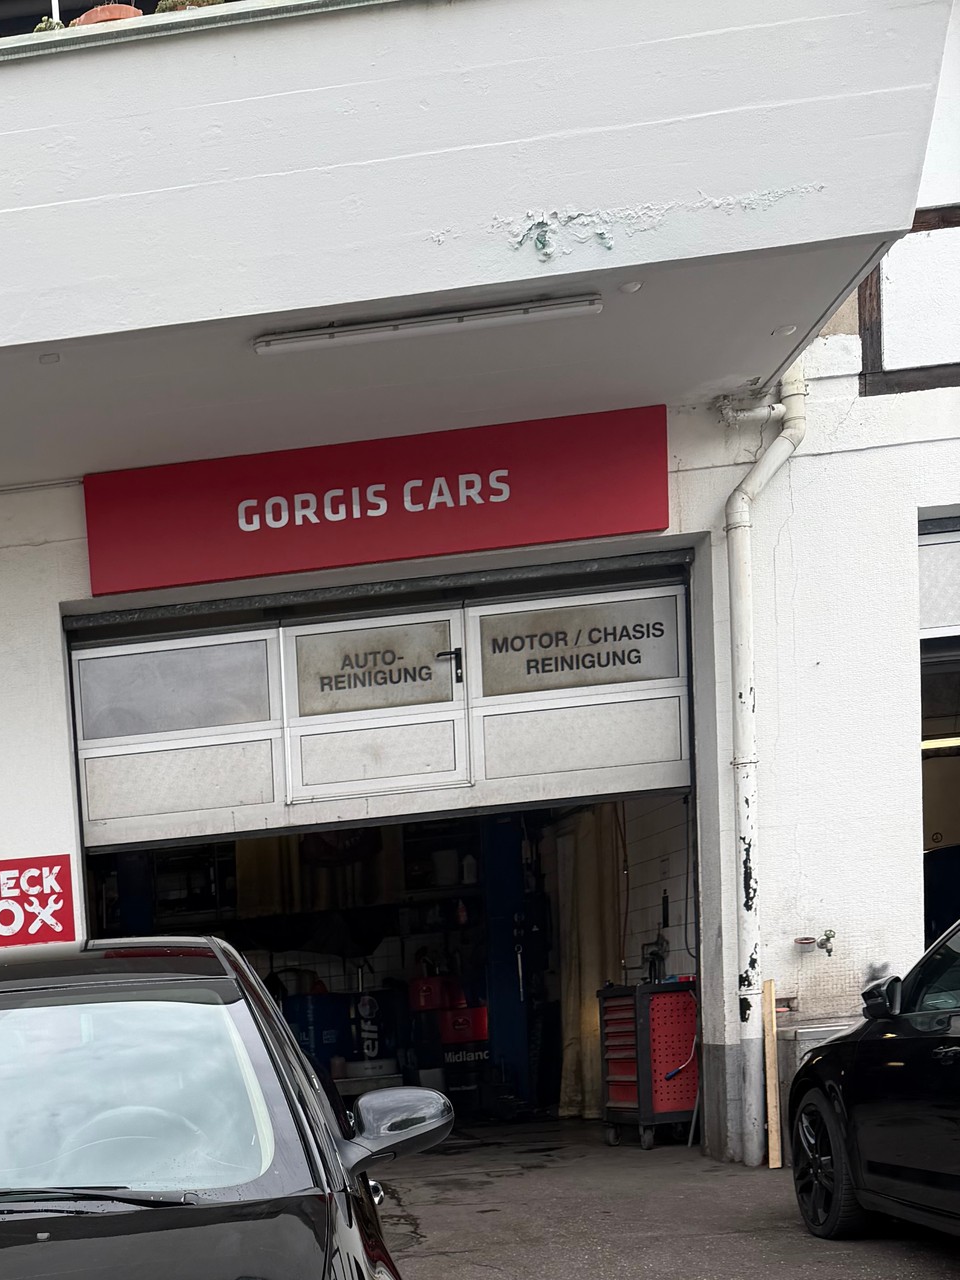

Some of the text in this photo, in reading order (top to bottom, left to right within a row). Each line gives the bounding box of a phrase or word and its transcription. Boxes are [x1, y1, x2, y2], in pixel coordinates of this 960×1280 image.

[237, 469, 511, 532] GORGIS CARS
[491, 631, 568, 654] MOTOR
[587, 621, 665, 644] CHASIS
[340, 649, 404, 671] AUTO-
[526, 648, 642, 675] REINIGUNG
[319, 665, 433, 692] REINIGUNG
[360, 1018, 378, 1058] elf
